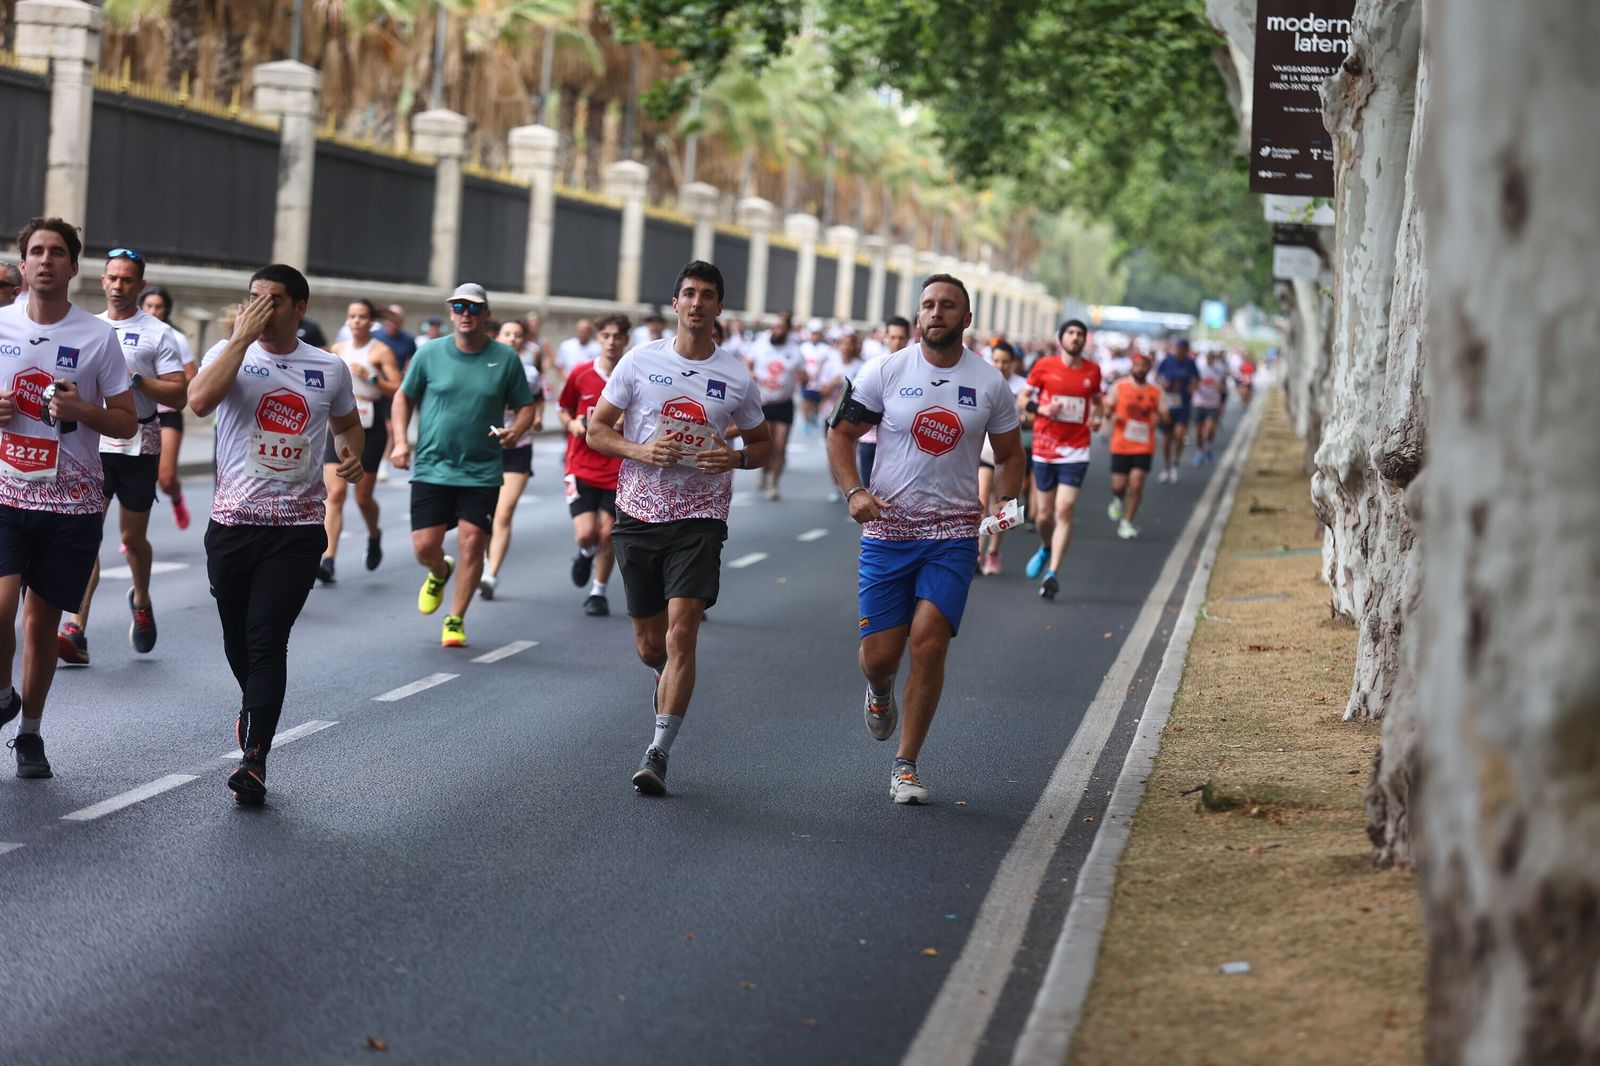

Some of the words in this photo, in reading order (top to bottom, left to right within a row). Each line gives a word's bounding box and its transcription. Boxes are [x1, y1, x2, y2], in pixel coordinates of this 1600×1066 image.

[1266, 12, 1351, 34] modern
[19, 378, 45, 395] PON
[306, 377, 322, 387] AXA
[16, 387, 45, 407] FREN
[706, 388, 722, 398] AXA
[958, 395, 974, 405] AXA
[266, 398, 305, 422] PONLE
[262, 409, 299, 431] FRENO
[921, 416, 959, 437] PONLE
[916, 425, 954, 445] FRENO
[5, 443, 50, 462] 2277
[258, 443, 303, 460] 1107
